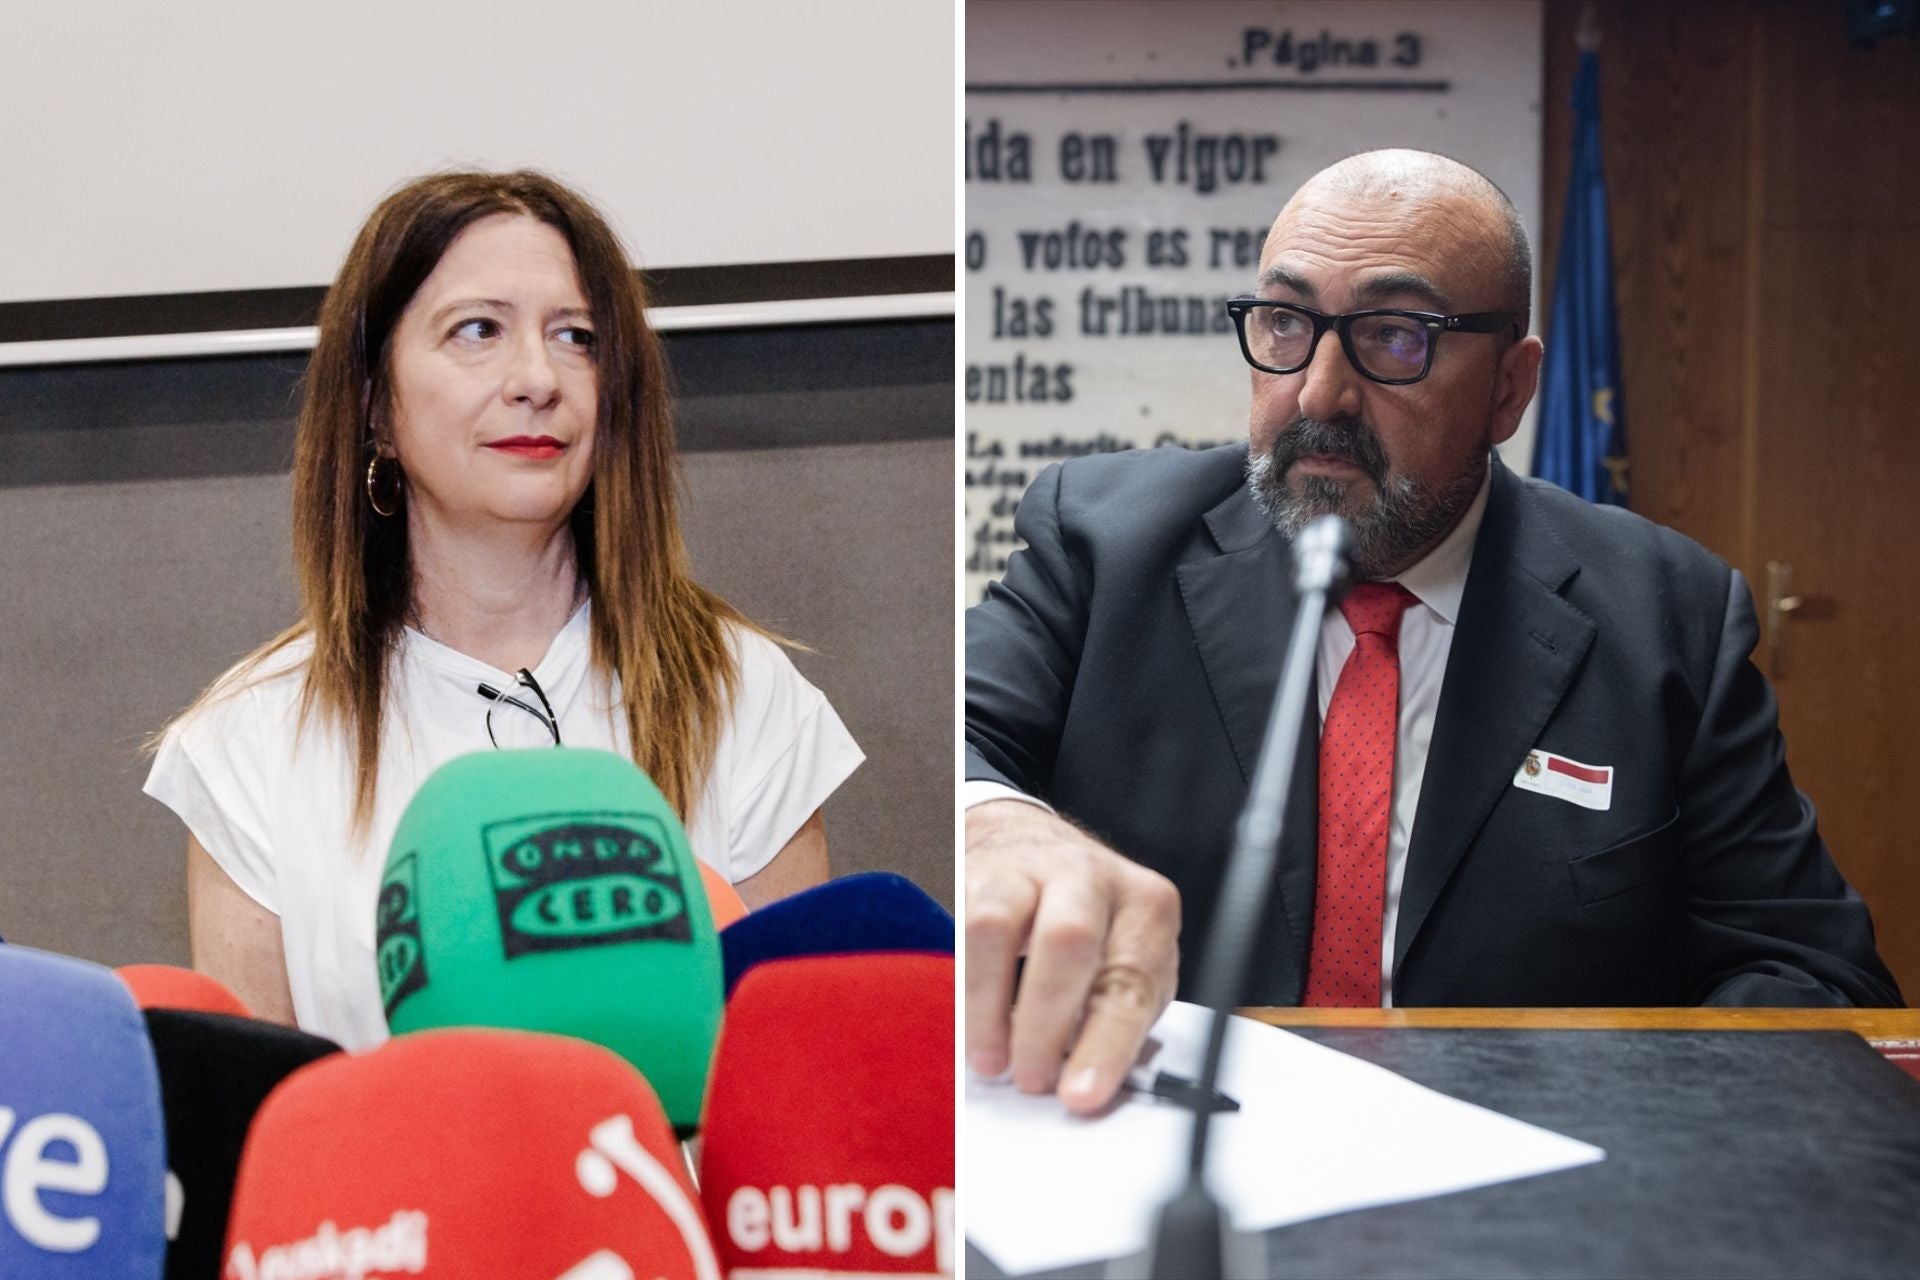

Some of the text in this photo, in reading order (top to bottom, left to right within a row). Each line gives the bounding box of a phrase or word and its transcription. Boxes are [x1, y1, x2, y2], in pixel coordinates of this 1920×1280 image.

[1392, 31, 1422, 68] 3
[1060, 130, 1117, 183] en
[1143, 120, 1280, 193] vigor
[1016, 220, 1127, 270] votos
[1146, 228, 1189, 268] es
[993, 287, 1055, 339] las
[514, 837, 650, 871] ONDA
[535, 885, 665, 925] CERO
[0, 1105, 109, 1253] e
